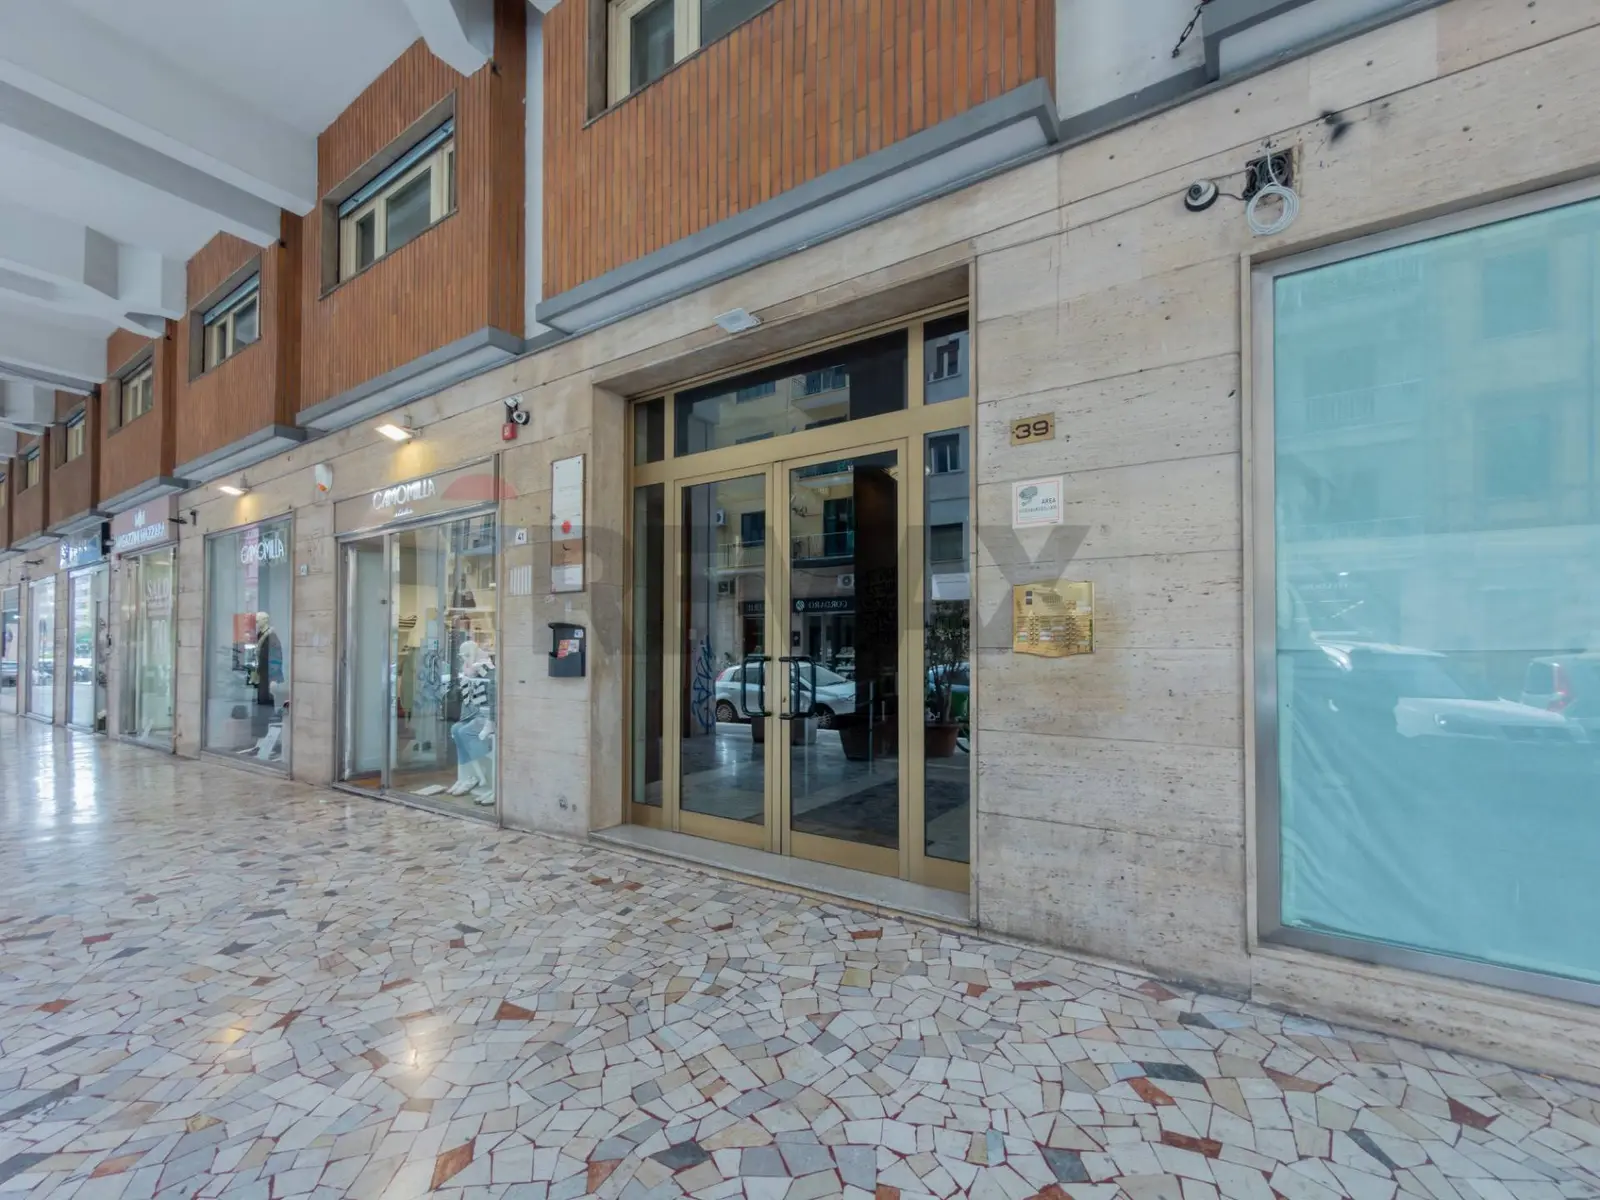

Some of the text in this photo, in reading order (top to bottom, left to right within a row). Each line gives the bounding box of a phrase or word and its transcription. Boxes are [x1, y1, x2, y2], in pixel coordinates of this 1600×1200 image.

[1015, 419, 1049, 440] 39
[372, 478, 436, 510] CAMOMILLA
[517, 531, 525, 541] 41
[240, 538, 285, 564] CAMOMILLA
